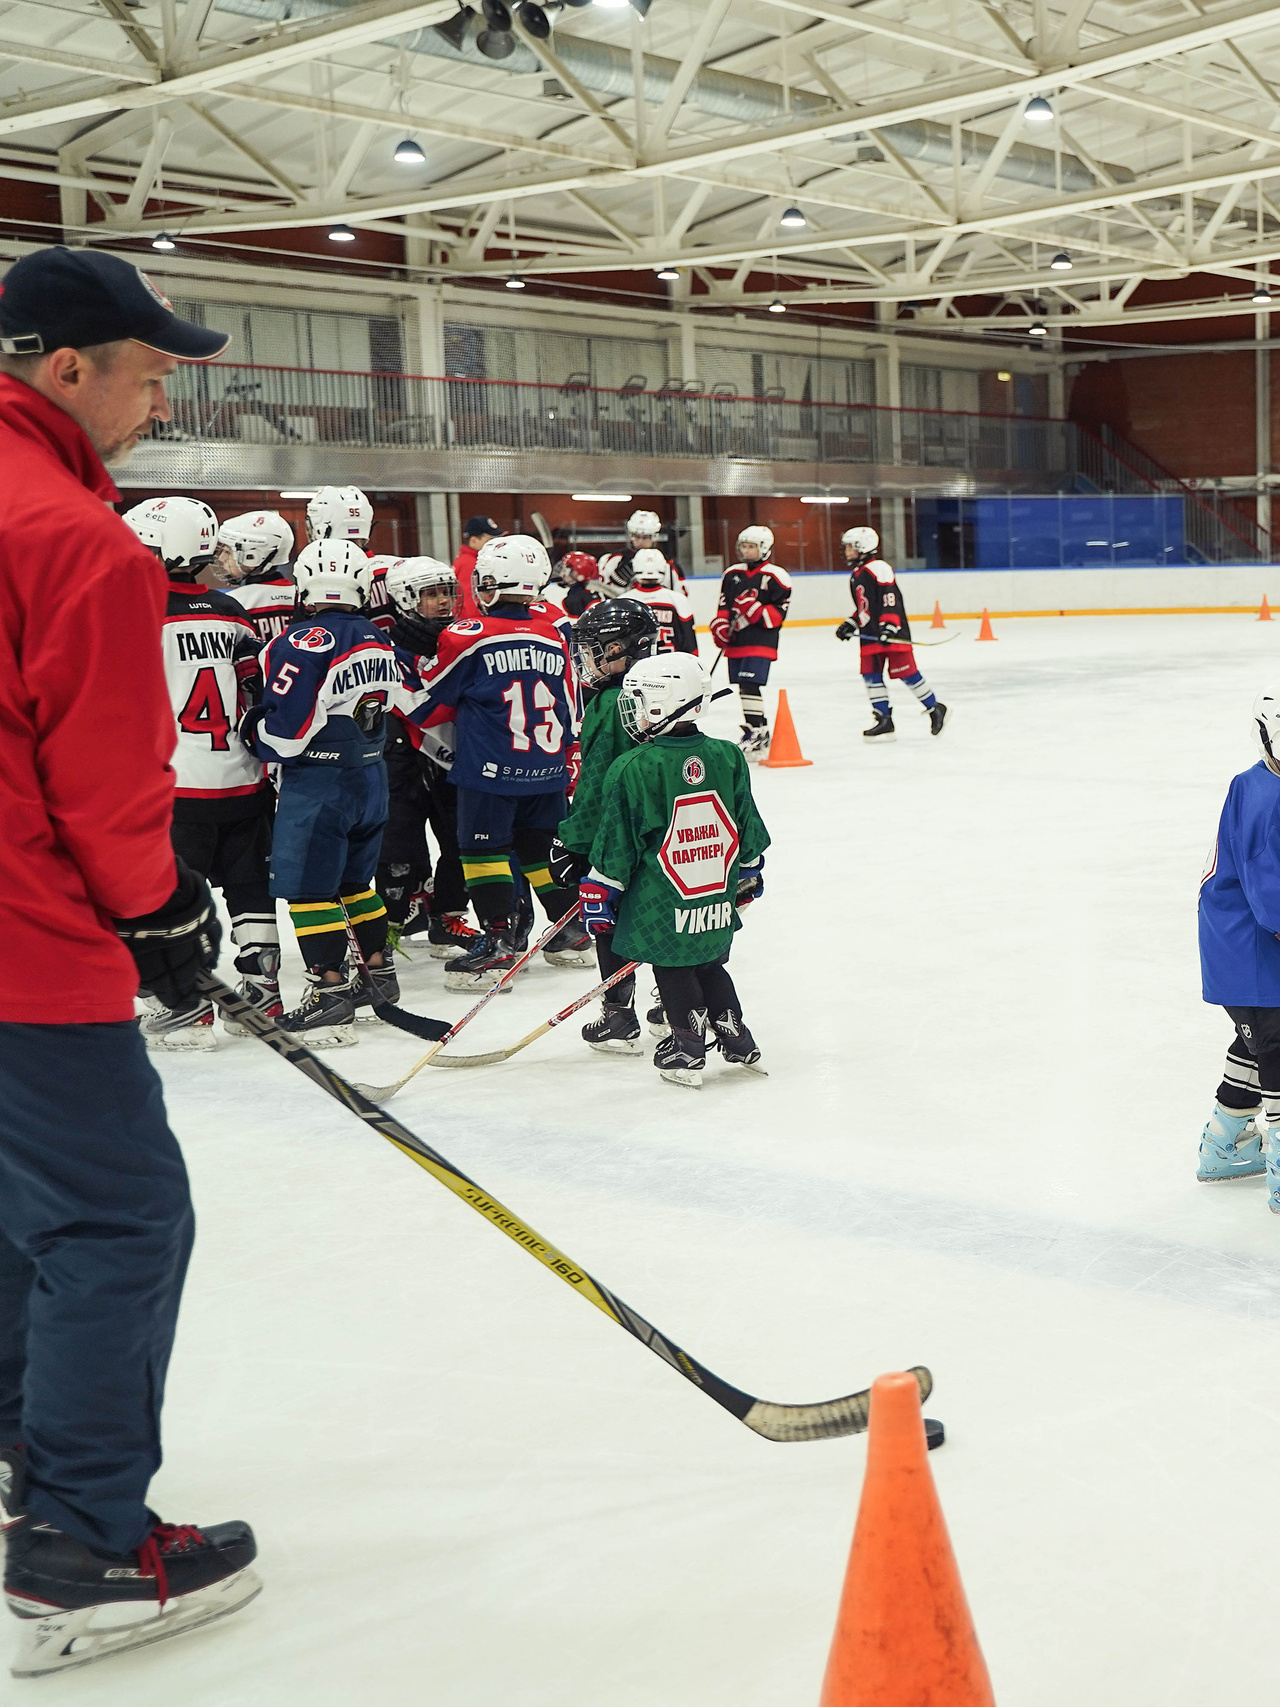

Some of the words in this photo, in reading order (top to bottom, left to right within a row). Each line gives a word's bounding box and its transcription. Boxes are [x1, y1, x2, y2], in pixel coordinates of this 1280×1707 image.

[348, 507, 361, 518] 95
[200, 527, 210, 538] 44
[329, 561, 337, 572] 5
[188, 602, 213, 610] LUTCH
[176, 631, 238, 662] ГАЛКИ
[271, 660, 301, 696] 5
[641, 682, 666, 690] BAUER
[177, 666, 231, 752] 4
[501, 678, 565, 755] 13
[303, 751, 341, 761] AUER
[674, 901, 733, 935] VIKHR
[197, 968, 302, 1055] AUER
[459, 1186, 546, 1257] SUPREME
[549, 1256, 585, 1287] 160
